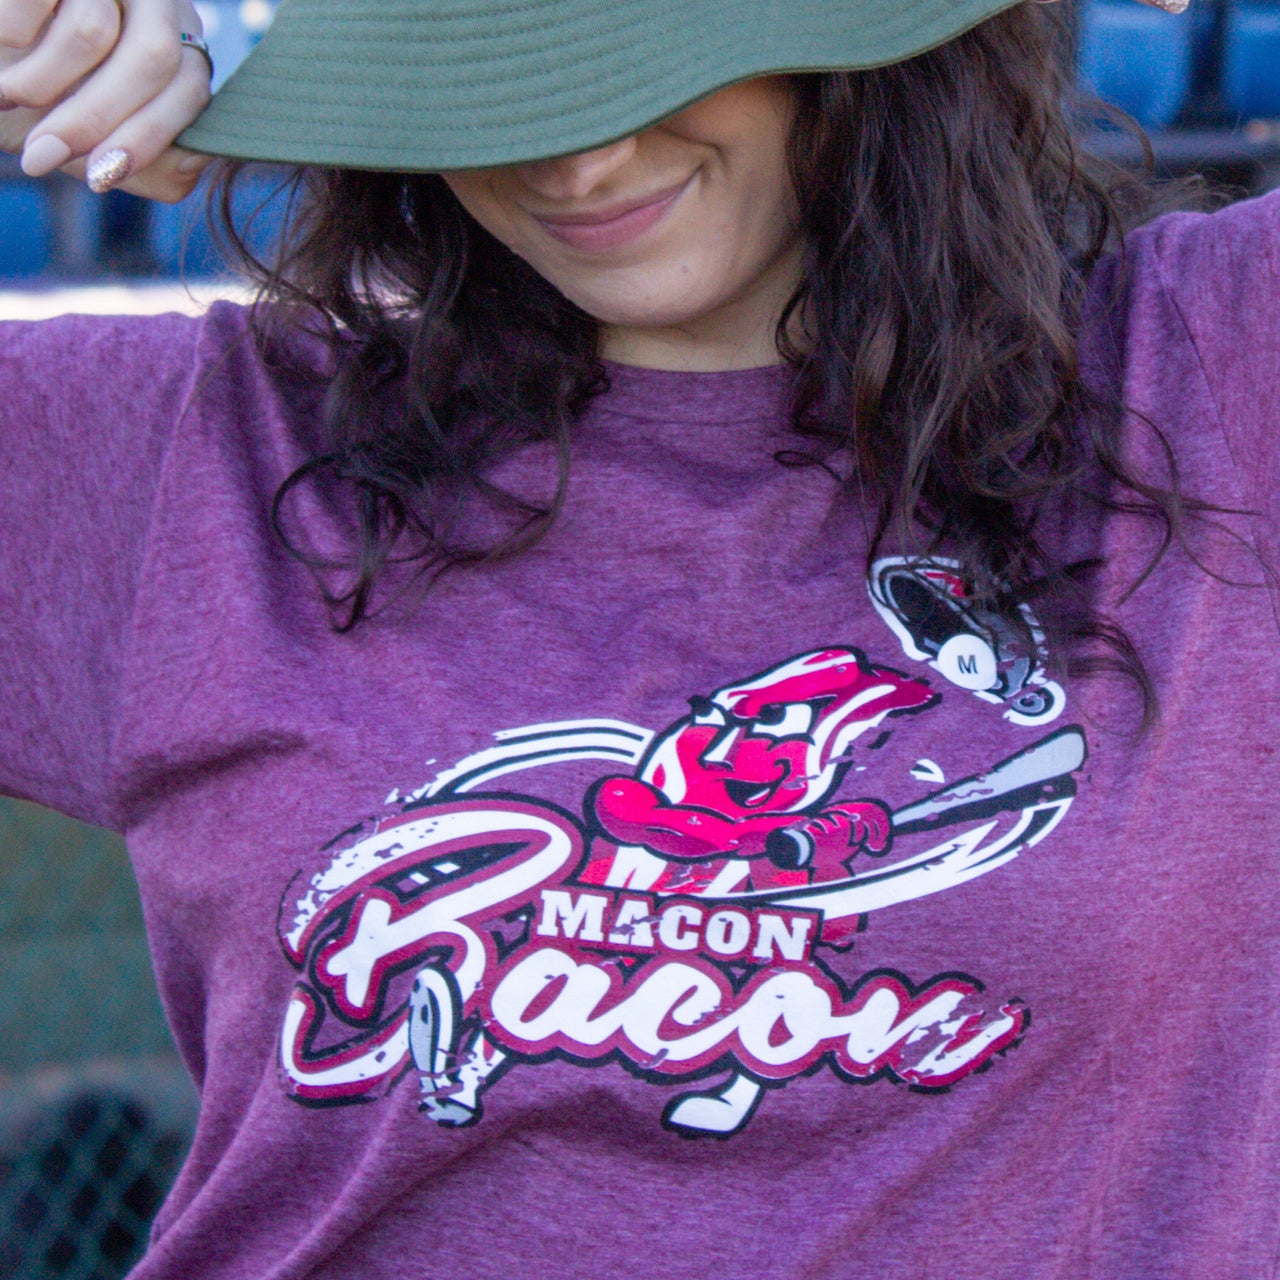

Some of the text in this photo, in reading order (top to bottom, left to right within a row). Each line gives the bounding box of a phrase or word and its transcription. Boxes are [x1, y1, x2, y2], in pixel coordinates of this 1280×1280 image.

[956, 654, 979, 675] M
[277, 798, 1028, 1100] Bacon
[535, 888, 813, 961] MACON
